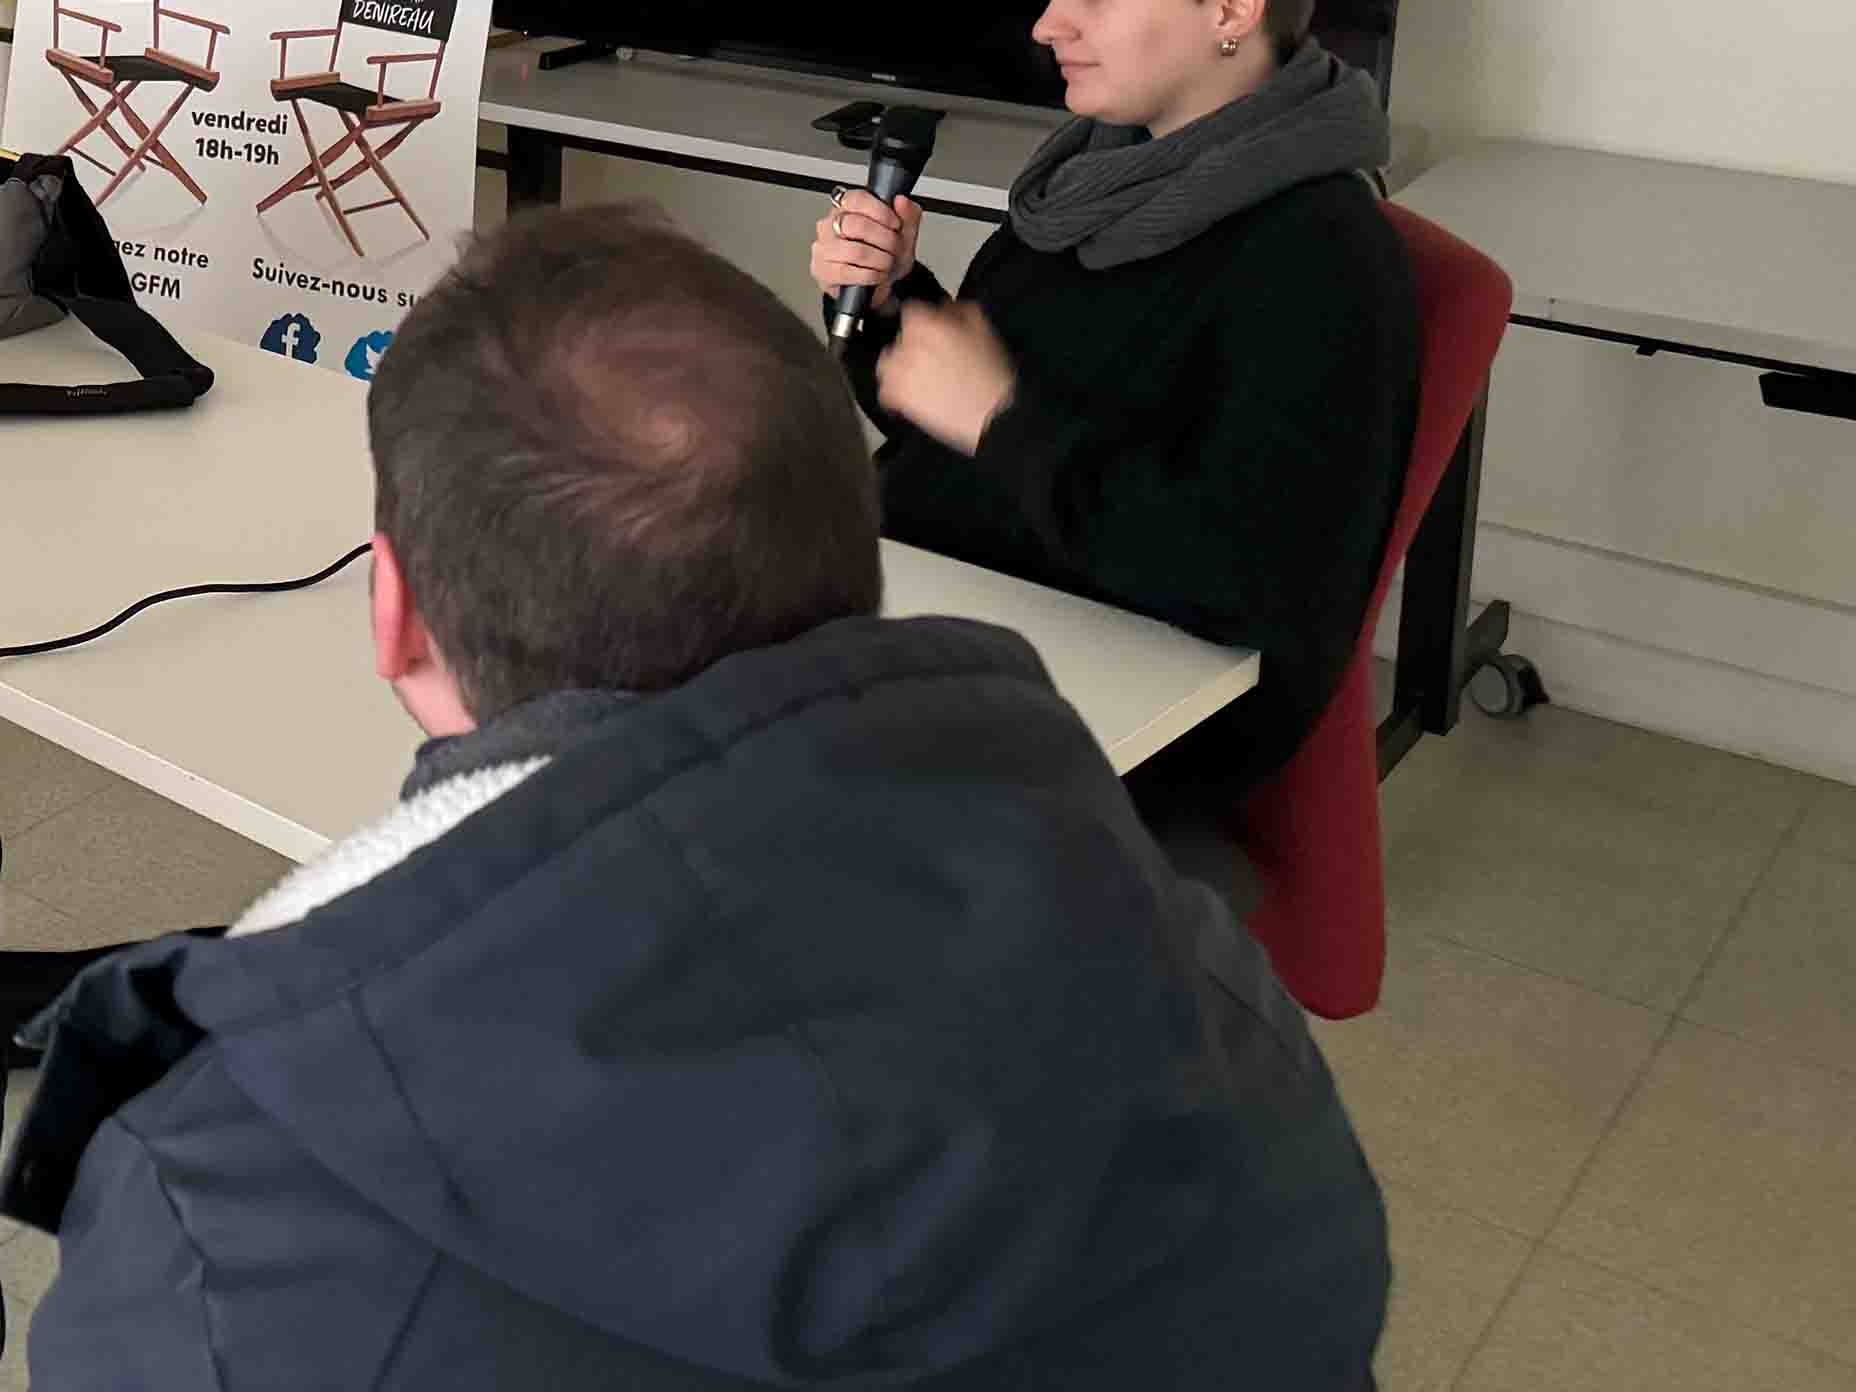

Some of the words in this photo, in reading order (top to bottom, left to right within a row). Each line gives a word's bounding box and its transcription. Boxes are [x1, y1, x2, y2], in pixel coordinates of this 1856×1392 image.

[352, 0, 435, 34] DENIREAU
[191, 108, 288, 135] vendredi
[195, 138, 280, 165] 18h-19h
[154, 246, 209, 268] notre
[252, 257, 388, 304] Suivez-nous
